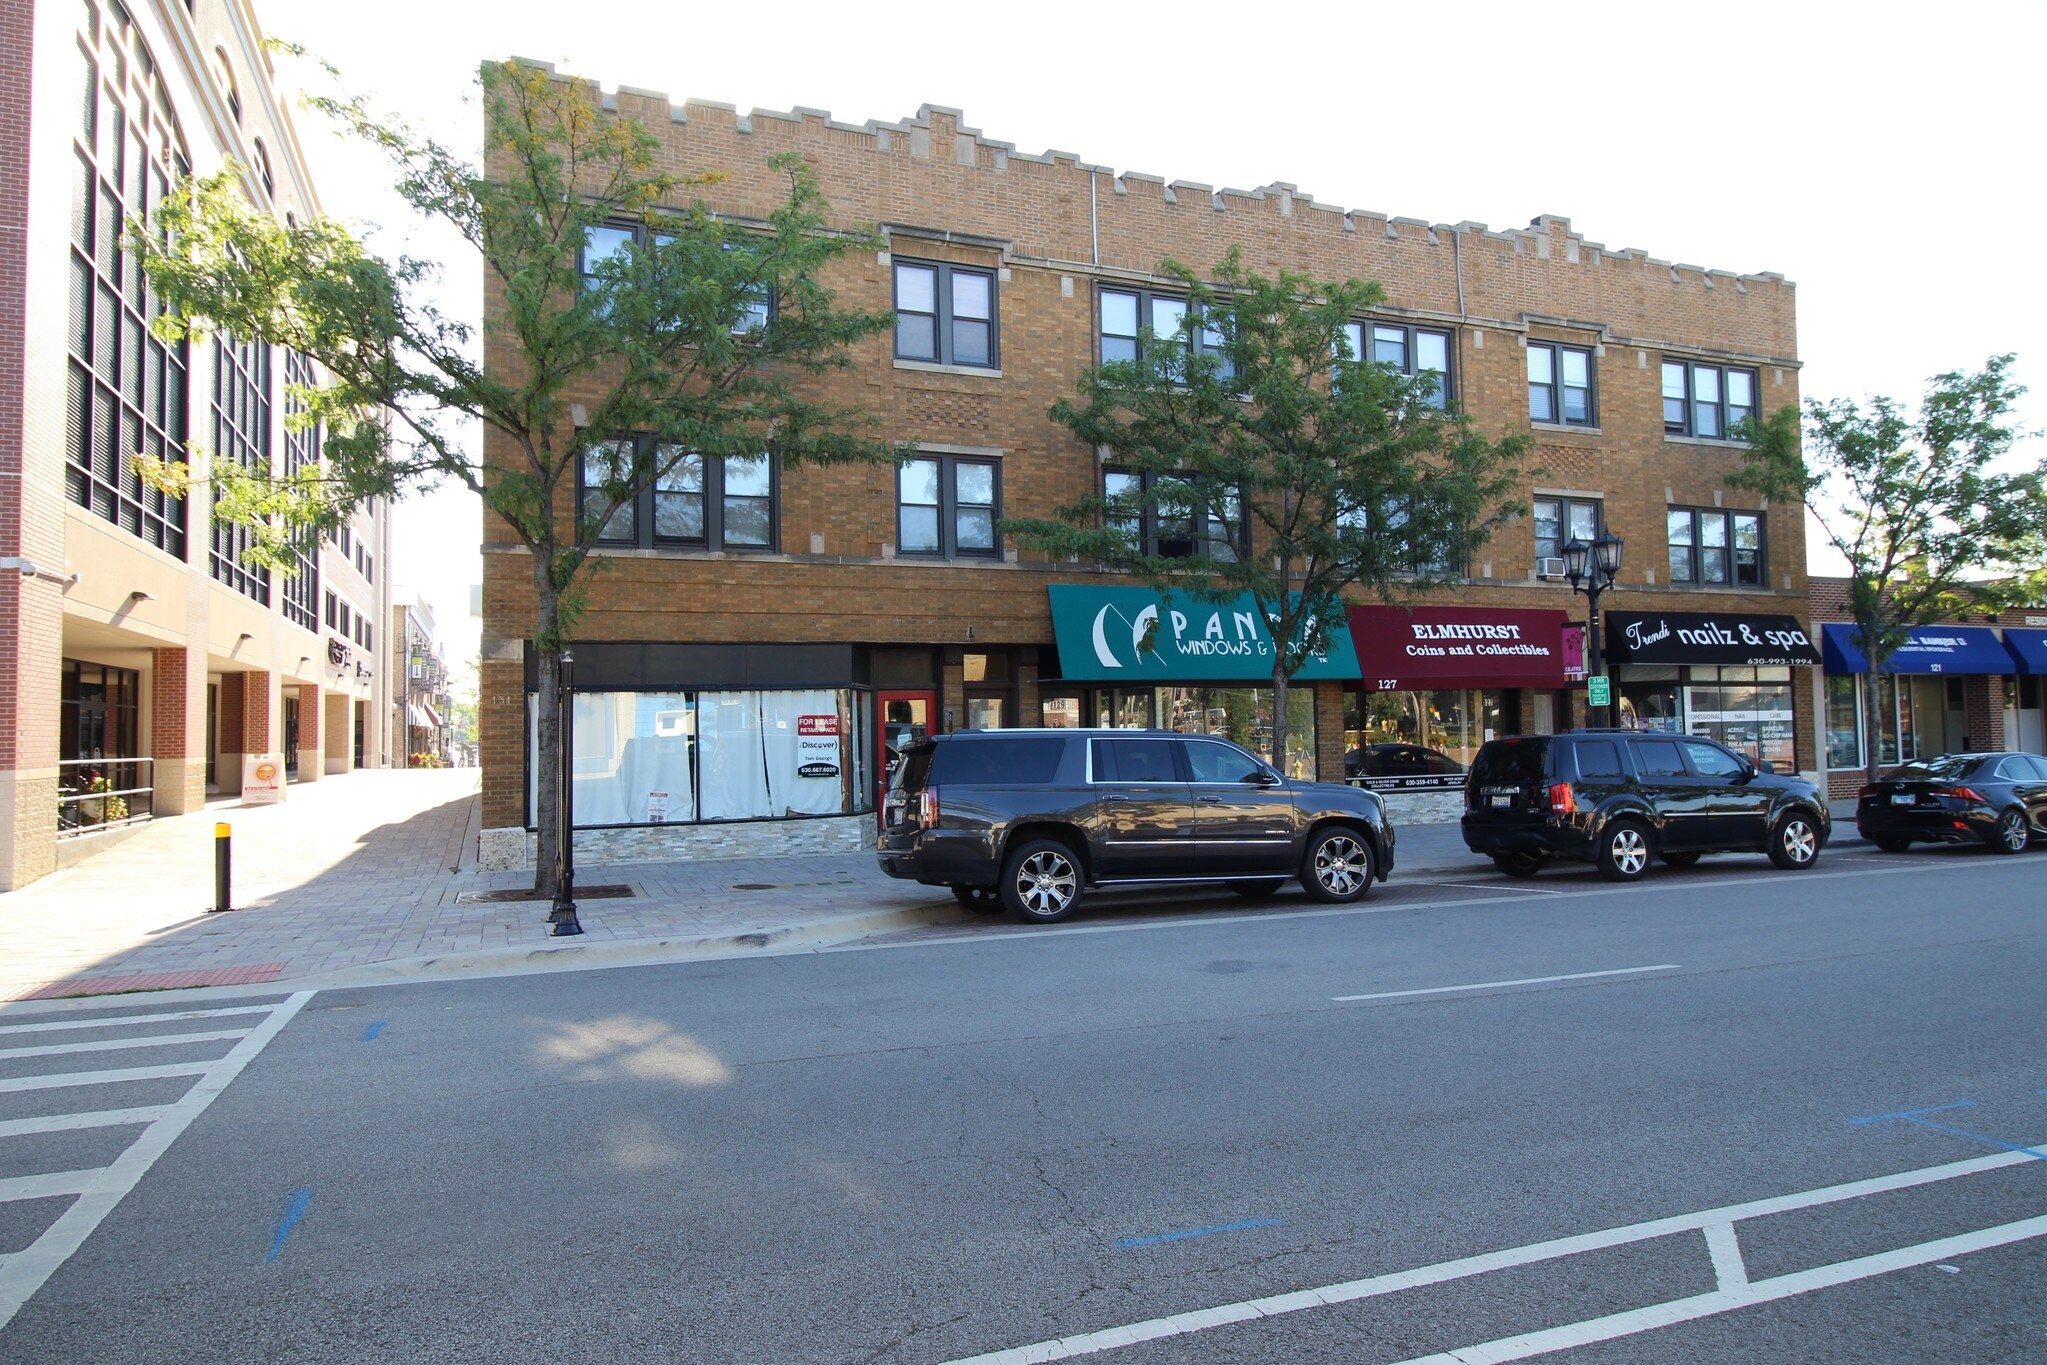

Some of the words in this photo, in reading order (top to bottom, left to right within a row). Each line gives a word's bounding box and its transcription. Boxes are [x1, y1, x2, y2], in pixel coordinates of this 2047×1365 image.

[1411, 624, 1520, 639] ELMHURST
[1626, 620, 1670, 650] Trendi
[1677, 622, 1738, 645] nailz
[1738, 623, 1763, 645] &
[1764, 629, 1809, 650] spa
[1919, 637, 1958, 646] BANKER
[1176, 640, 1251, 655] WINDOWS
[1257, 641, 1267, 656] &
[1406, 645, 1446, 656] Coins
[1449, 645, 1474, 655] and
[1476, 644, 1550, 656] Collectibles
[1931, 664, 1941, 672] 121
[1378, 679, 1397, 689] 127
[492, 696, 510, 704] 131
[1053, 700, 1065, 709] 129
